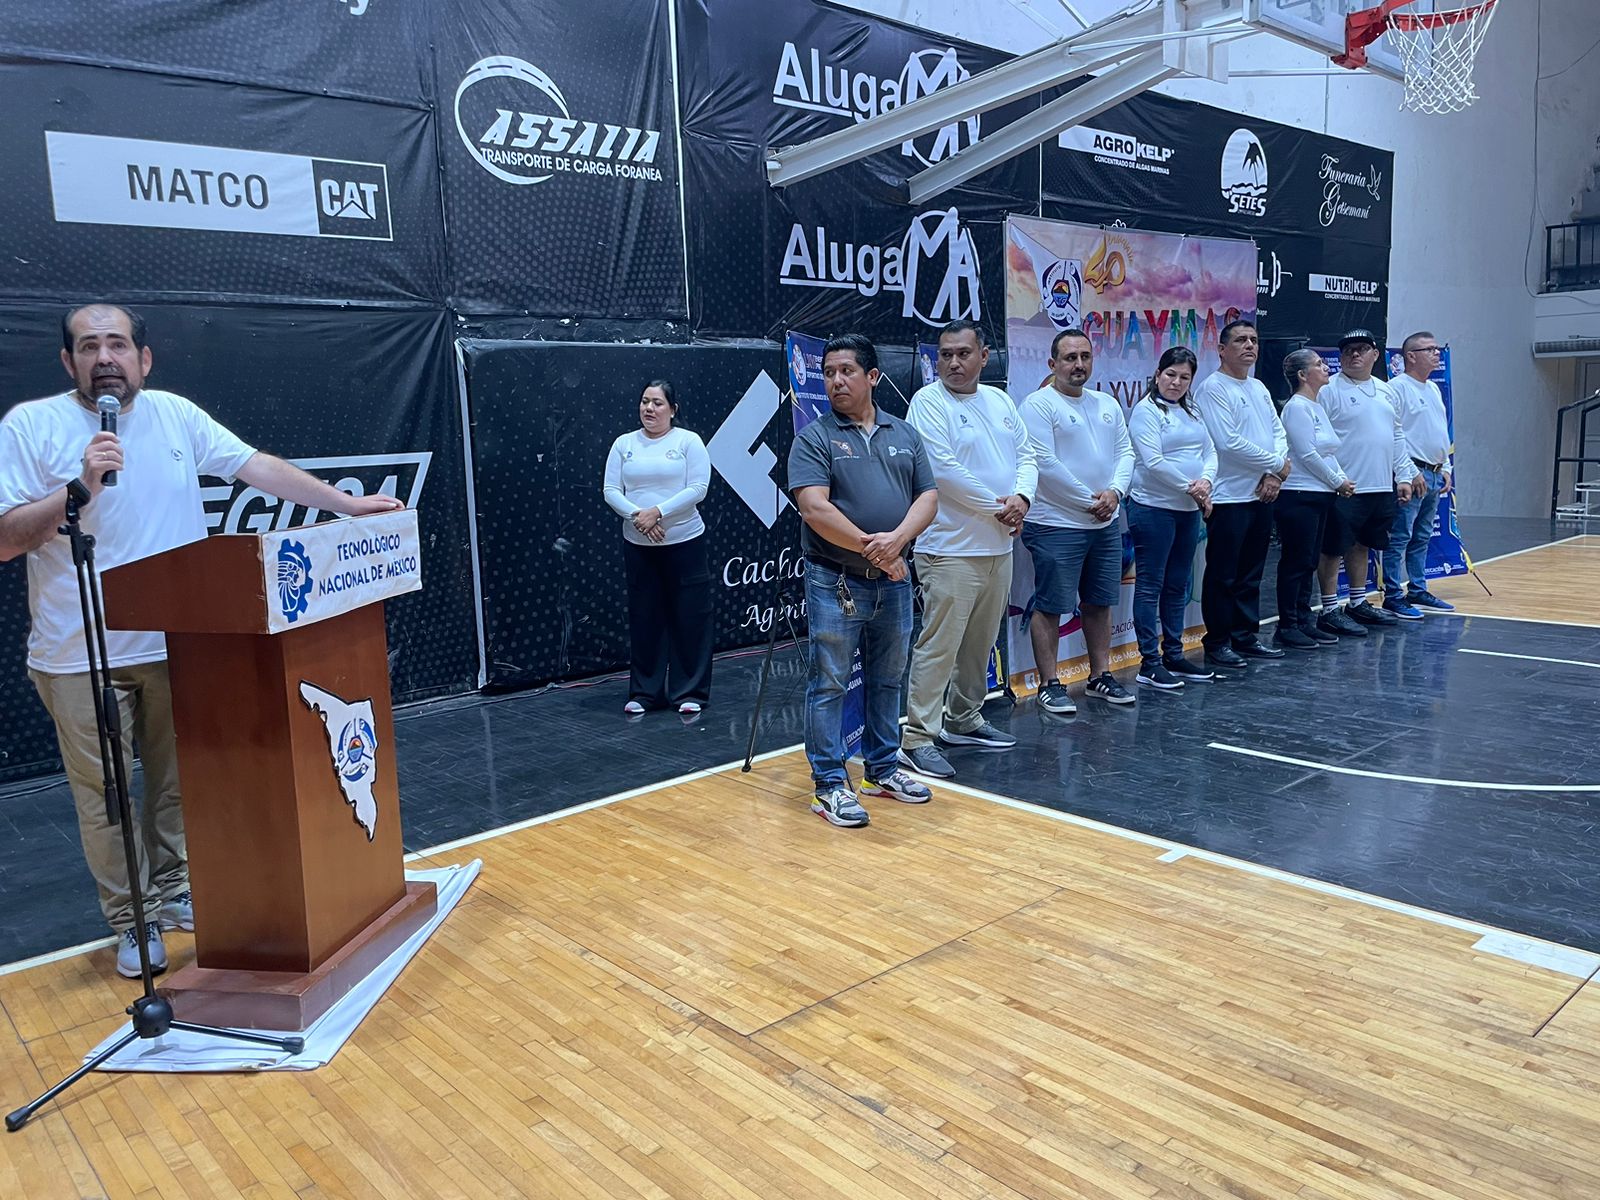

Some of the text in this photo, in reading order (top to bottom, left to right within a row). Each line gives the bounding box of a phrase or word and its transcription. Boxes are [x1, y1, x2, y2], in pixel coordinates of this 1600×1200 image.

[479, 109, 661, 164] ASSALIA
[480, 148, 662, 181] TRANSPORTE DE CARGA FORANEA
[1094, 155, 1128, 168] CONCENTRADO
[1128, 161, 1136, 169] DE
[1136, 163, 1150, 172] ALGAS
[1318, 153, 1366, 188] Funeraria
[126, 164, 270, 210] MATCO
[320, 177, 379, 220] CAT
[1228, 194, 1267, 216] SETES
[337, 533, 400, 562] TECNOLÓGICO
[319, 556, 417, 596] NACIONAL DE MÉXICO
